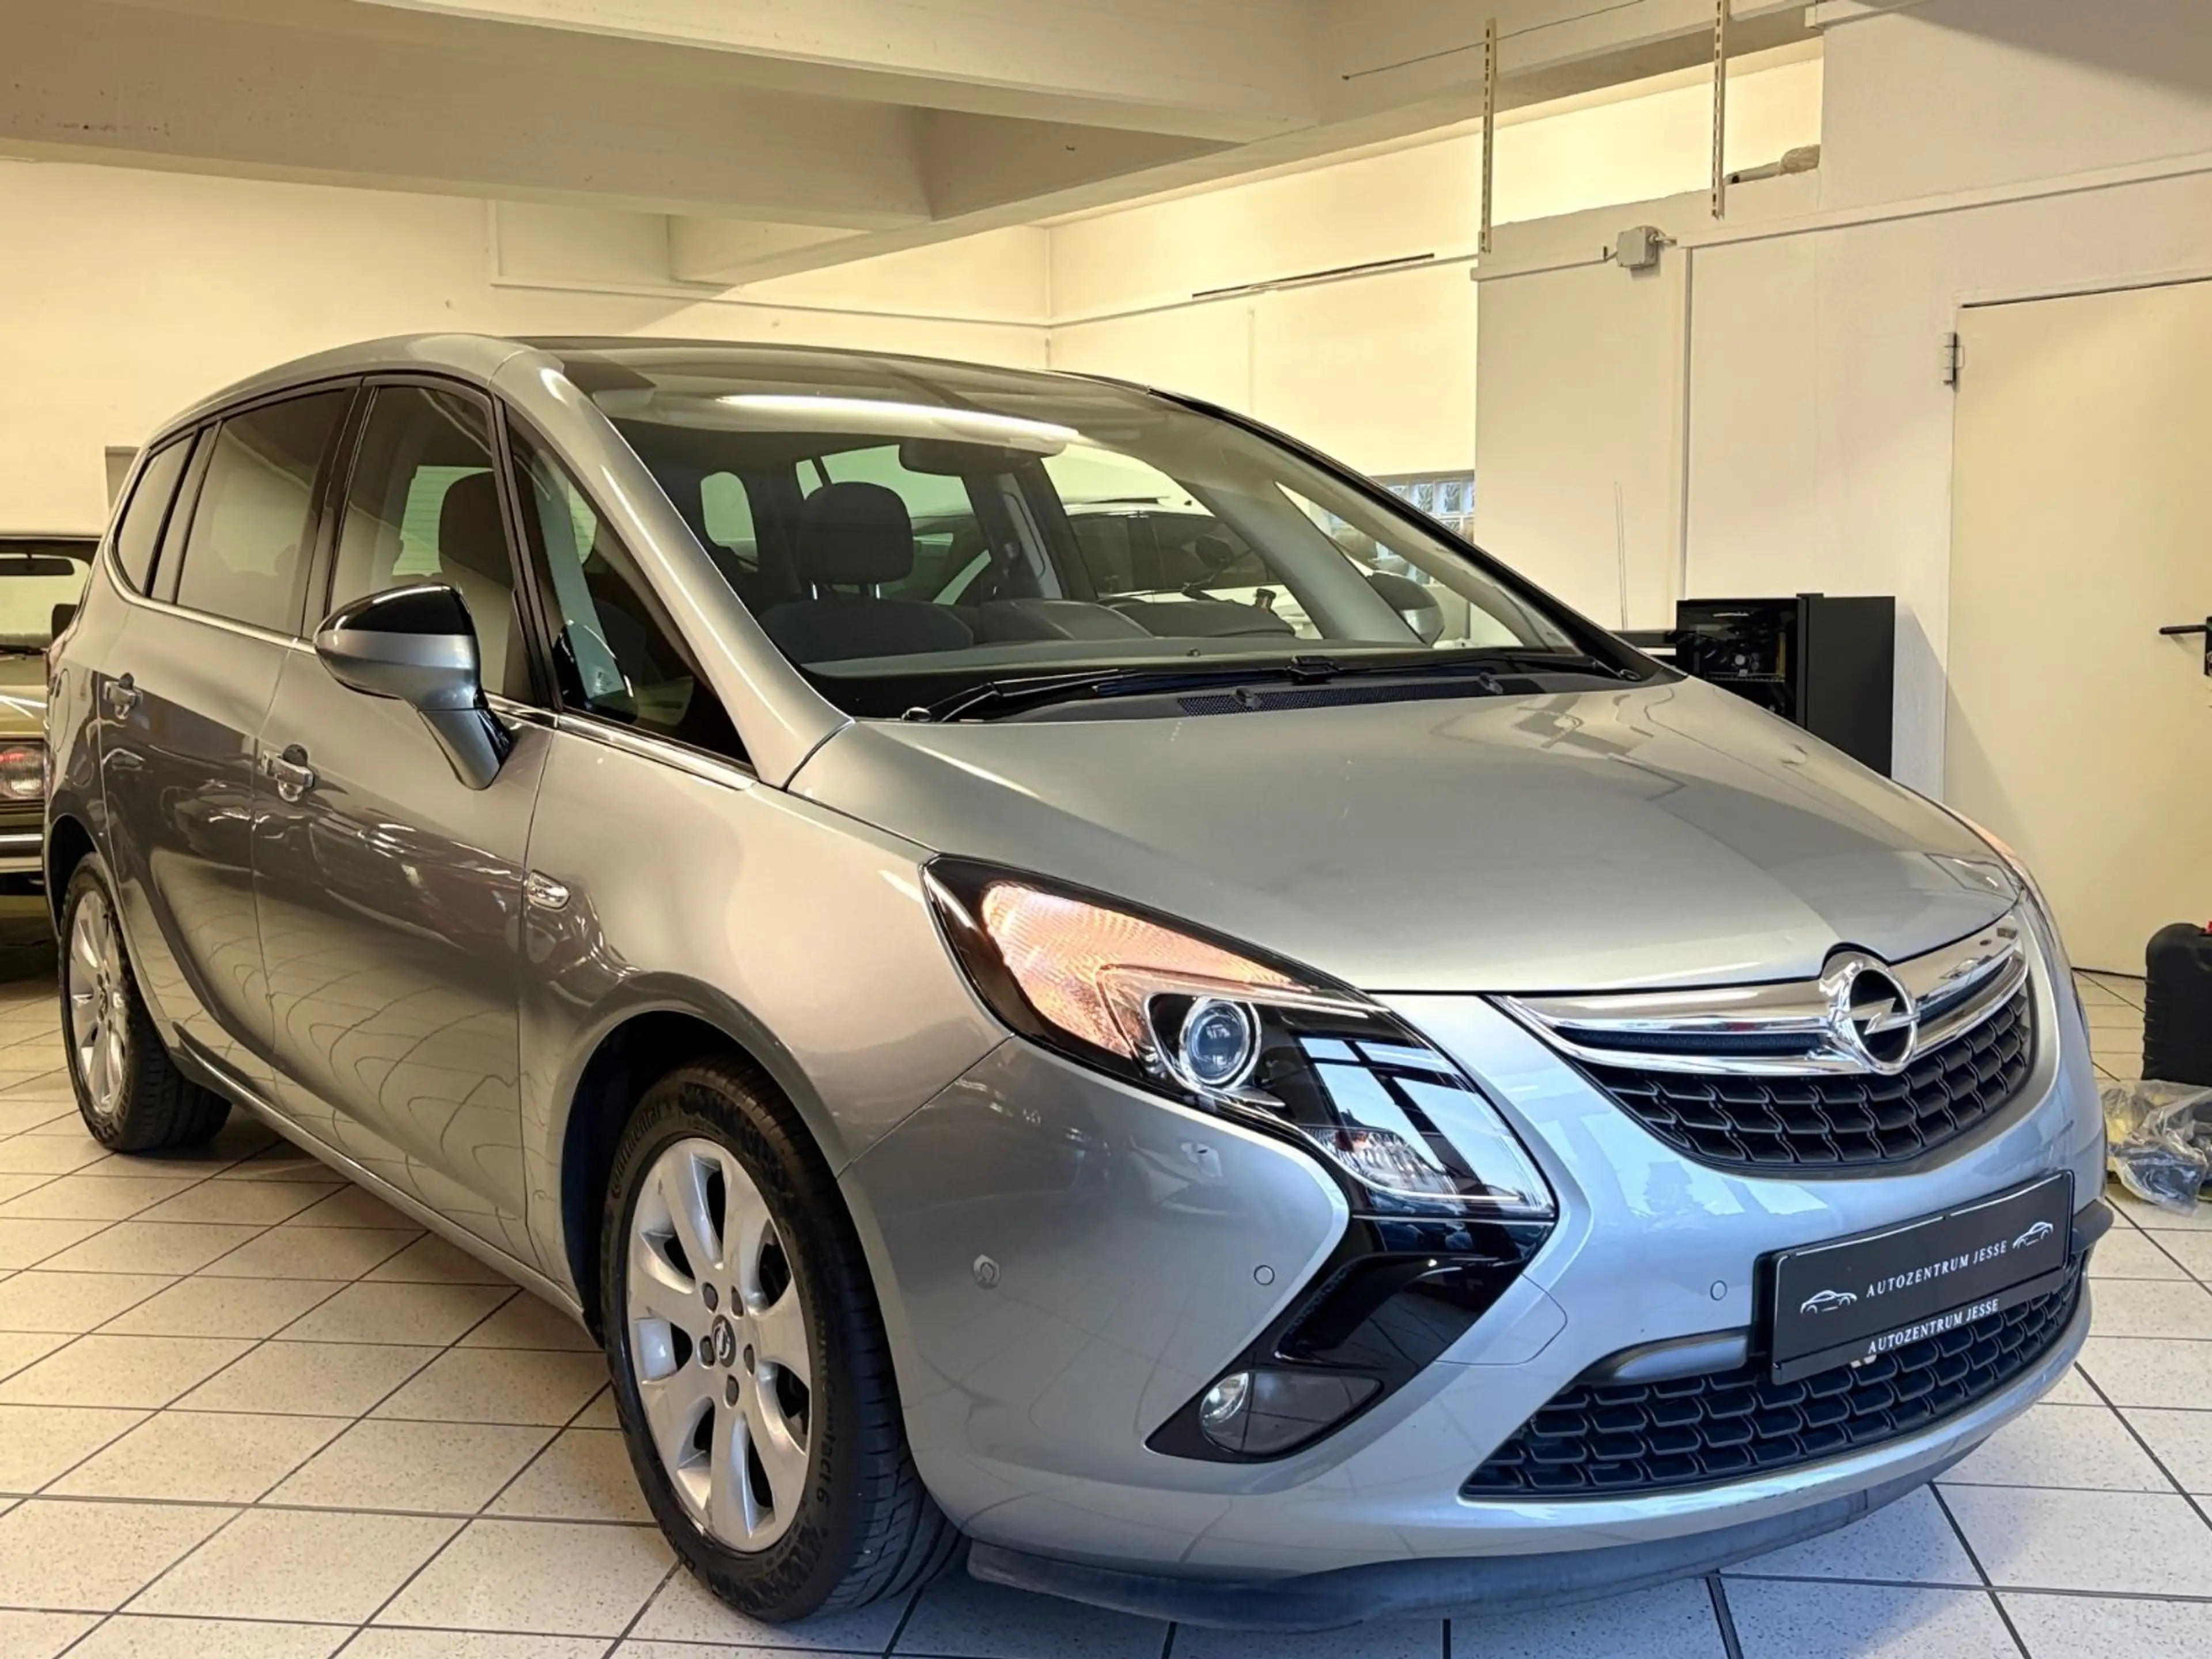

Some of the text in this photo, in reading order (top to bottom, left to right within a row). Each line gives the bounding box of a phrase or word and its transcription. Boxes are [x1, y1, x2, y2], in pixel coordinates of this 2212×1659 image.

[1866, 1240, 2008, 1298] AUTOZENTRUM JESSE
[1867, 1298, 1999, 1354] AUTOZENTRUM JESSE
